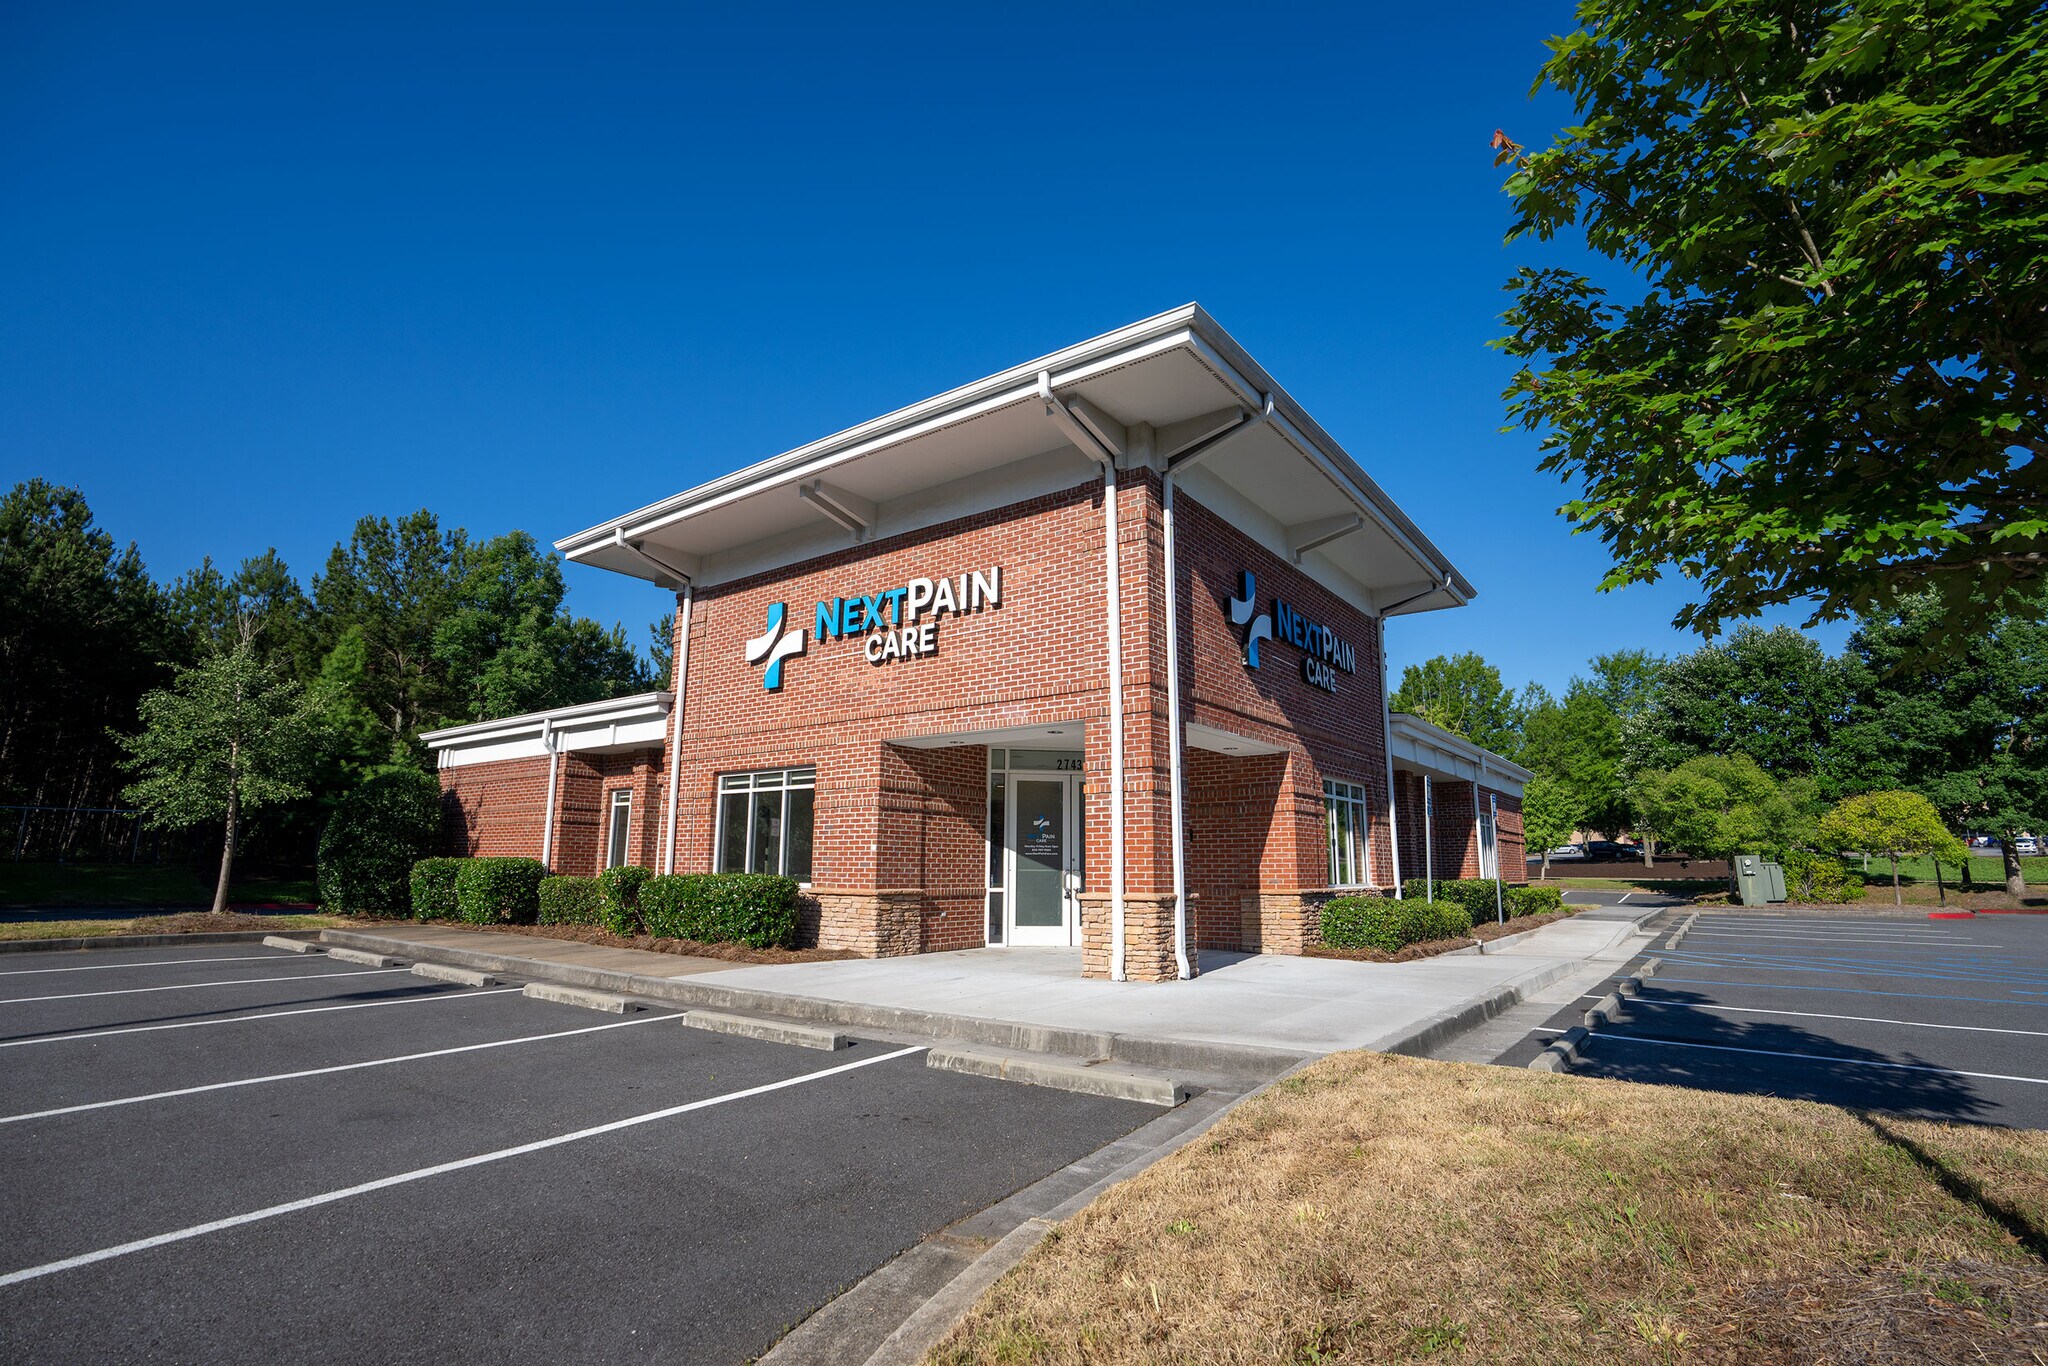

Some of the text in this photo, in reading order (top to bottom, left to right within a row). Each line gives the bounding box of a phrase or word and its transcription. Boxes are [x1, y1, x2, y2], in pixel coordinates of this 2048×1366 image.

[815, 566, 1000, 640] NEXTPAIN
[864, 622, 936, 663] CARE
[1277, 598, 1356, 675] NEXTPAIN
[1306, 657, 1337, 693] CARE
[1057, 759, 1082, 771] 2743
